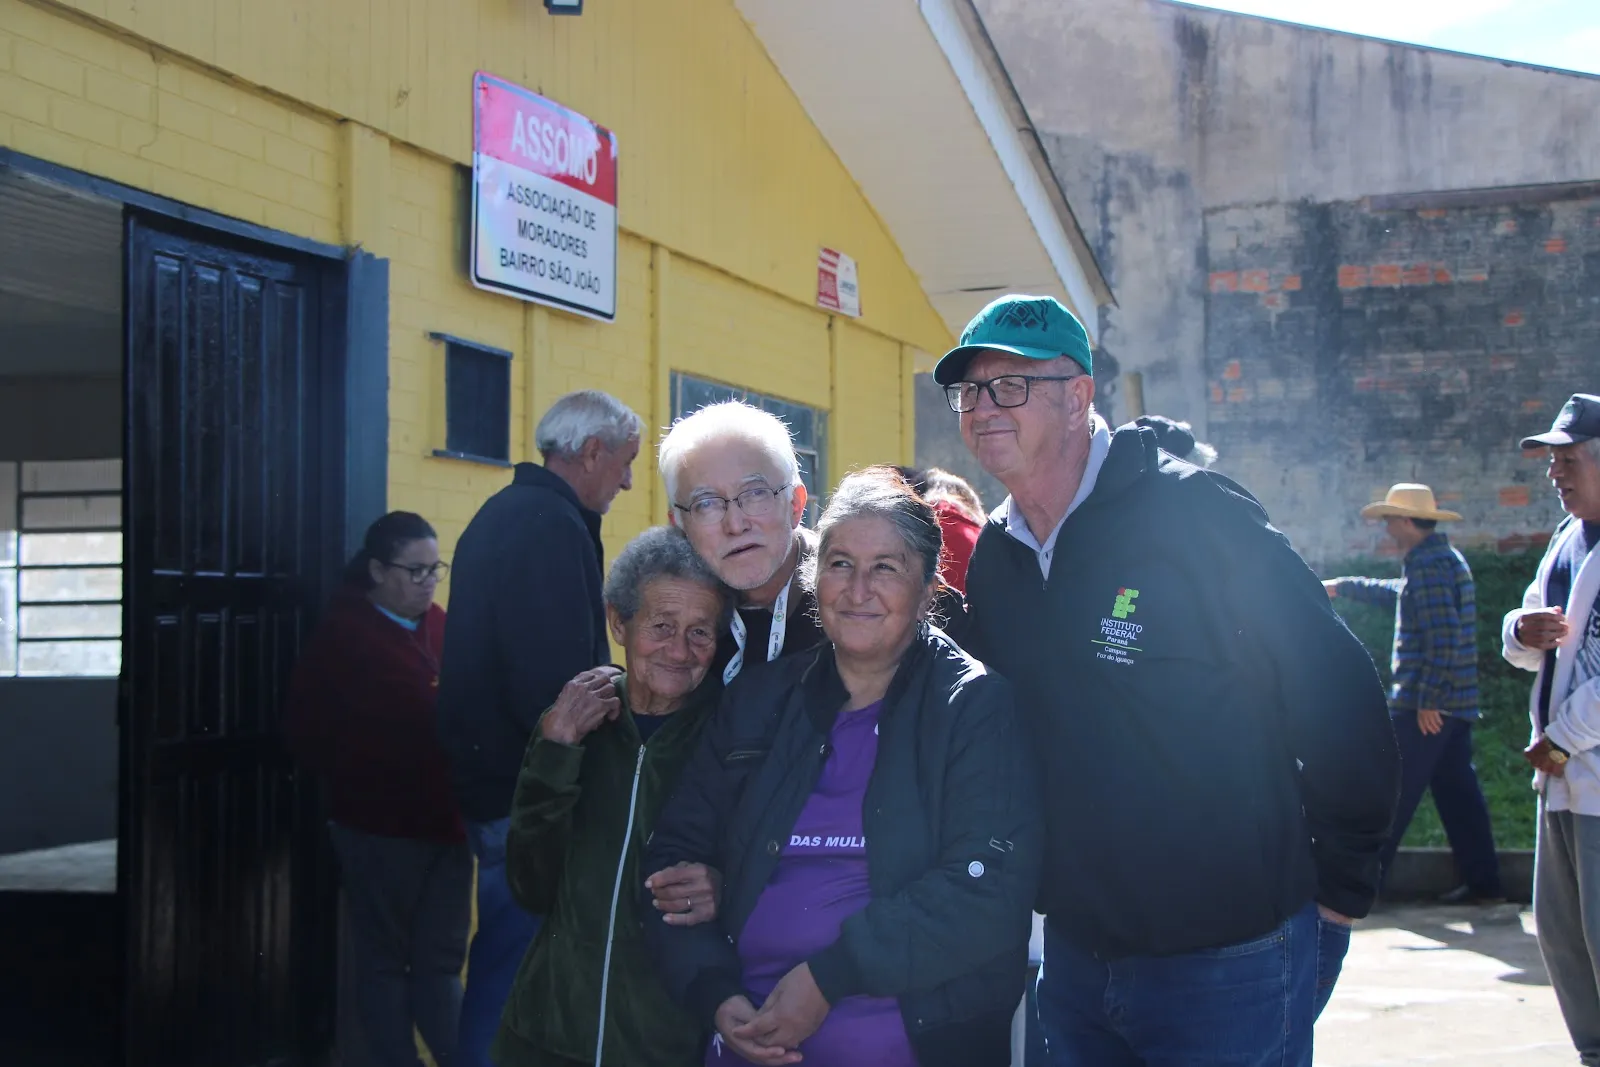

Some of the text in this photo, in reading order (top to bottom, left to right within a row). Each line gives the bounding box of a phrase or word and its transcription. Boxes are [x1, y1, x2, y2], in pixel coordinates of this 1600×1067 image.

[511, 110, 598, 186] ASSOMO
[507, 181, 596, 231] ASSOCIAÇÃO DE
[518, 218, 588, 259] MORADORES
[500, 247, 600, 294] BAIRRO SÃO JOÃO
[1101, 618, 1143, 633] INSTITUTO
[1101, 626, 1137, 640] FEDERAL
[1106, 635, 1129, 646] Paraná
[790, 834, 821, 847] DAS
